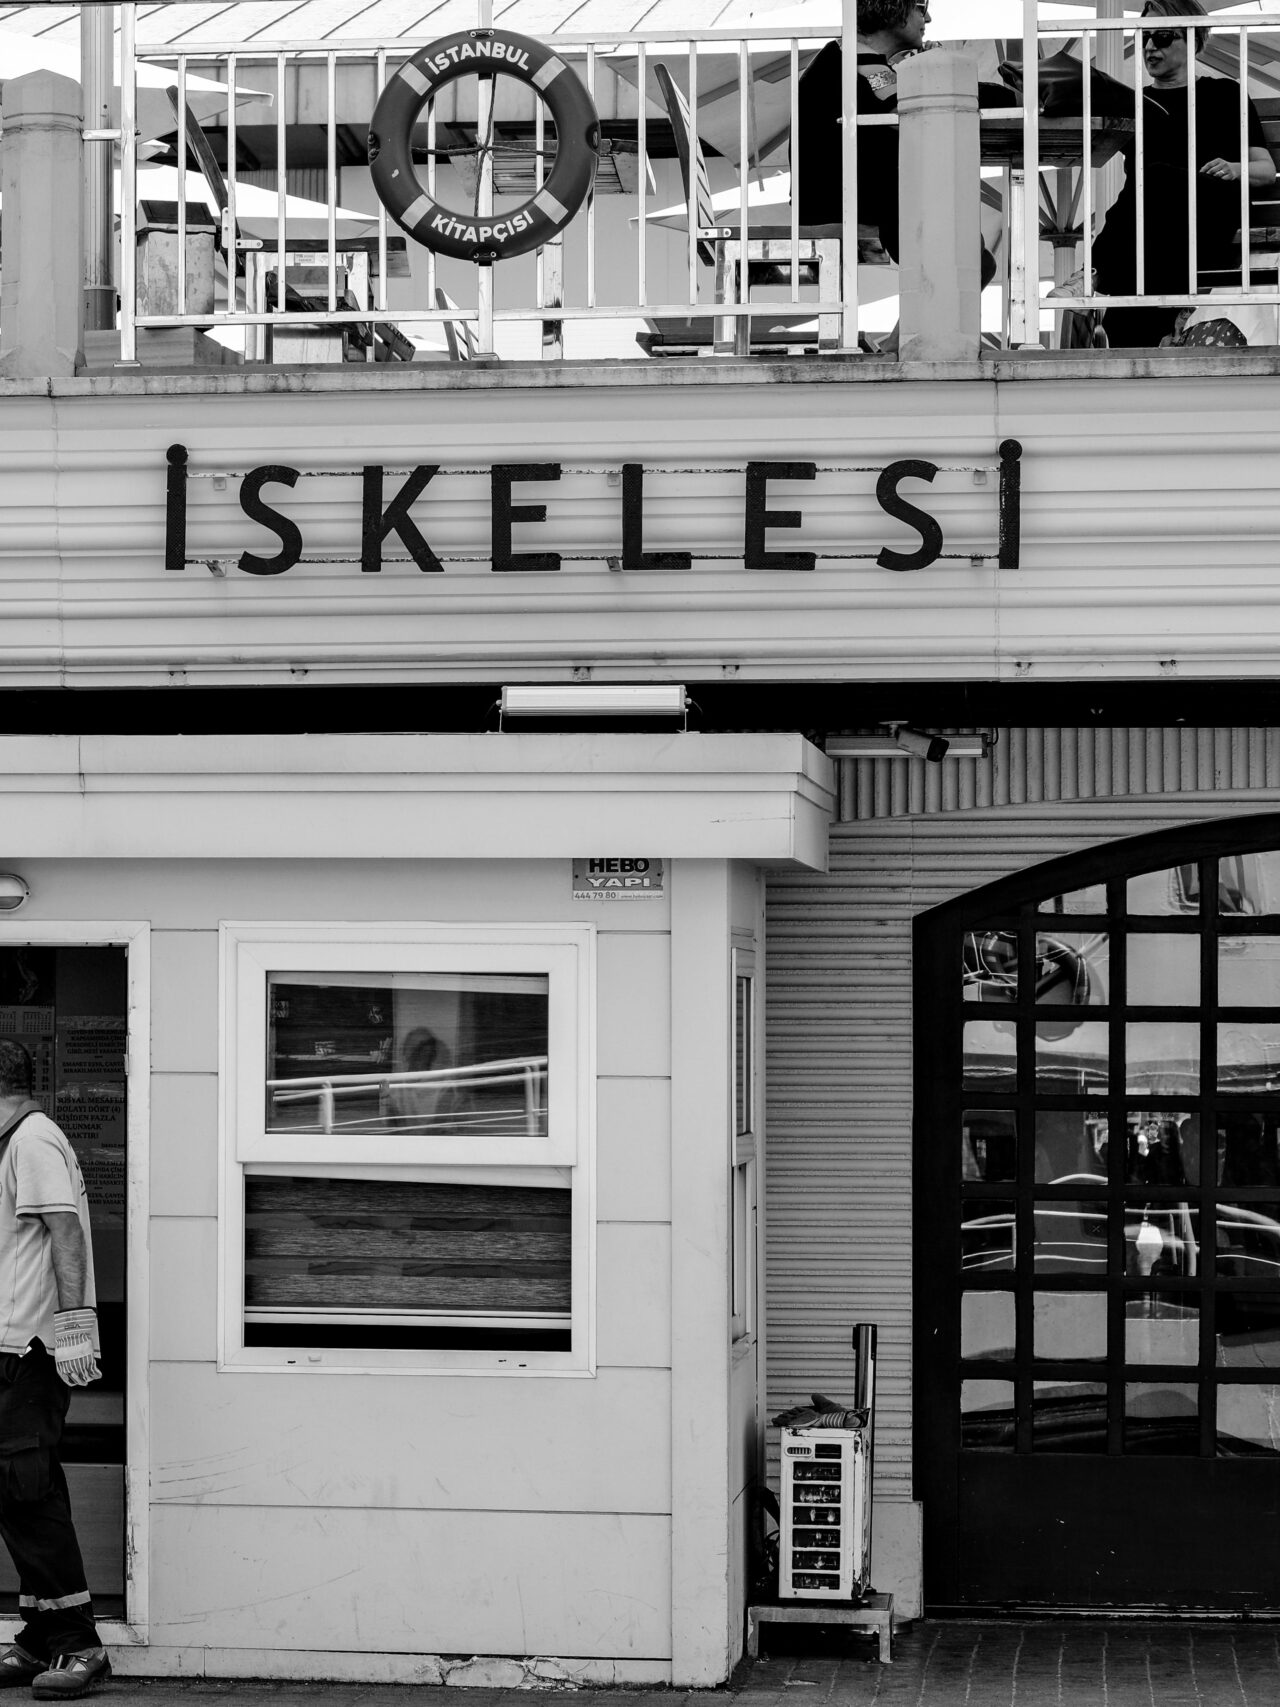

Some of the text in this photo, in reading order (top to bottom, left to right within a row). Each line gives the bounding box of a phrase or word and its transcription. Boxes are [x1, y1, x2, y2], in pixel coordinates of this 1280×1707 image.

[424, 41, 530, 75] İSTANBUL
[430, 210, 534, 243] KİTAPÇISI
[164, 438, 1022, 575] İSKELESİ
[587, 877, 651, 888] YAPI
[574, 891, 592, 899] 444
[593, 891, 604, 899] 79
[605, 891, 617, 899] 80
[56, 1105, 87, 1113] DOLAYI
[88, 1104, 110, 1113] DÖRT
[56, 1113, 89, 1122] KİŞİDEN
